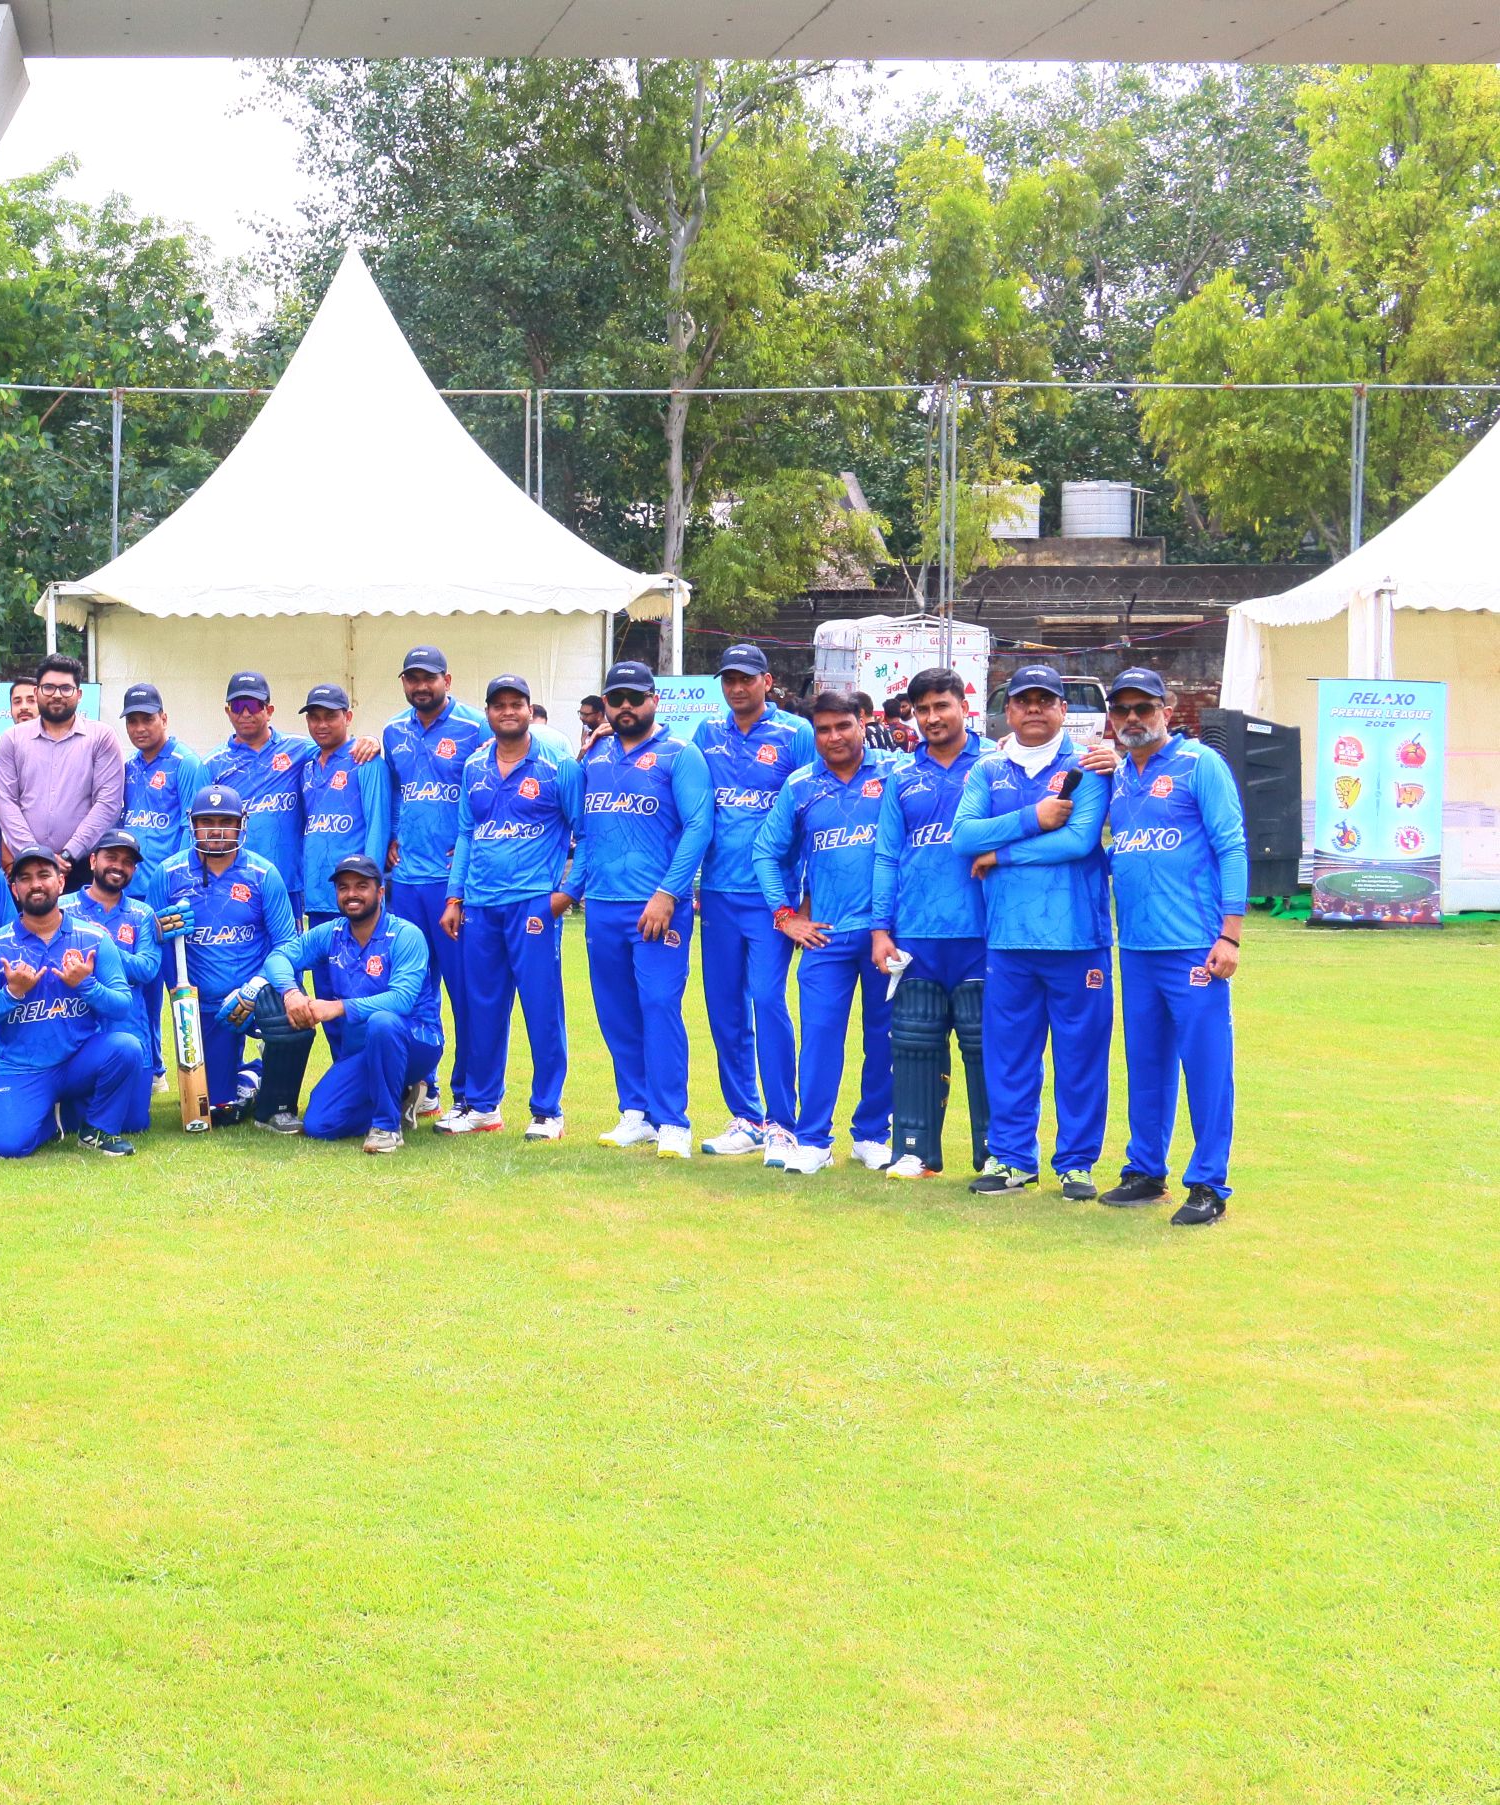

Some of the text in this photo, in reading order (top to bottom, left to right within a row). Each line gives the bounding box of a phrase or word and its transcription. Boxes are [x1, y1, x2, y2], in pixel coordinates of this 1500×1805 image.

[956, 637, 966, 646] JI
[655, 703, 720, 713] MIER LEAGUE
[1348, 692, 1416, 706] RELAXO
[1330, 707, 1433, 720] PREMIER LEAGUE
[1364, 720, 1396, 728] 2026
[241, 791, 298, 814] ELAXO
[583, 792, 659, 815] RELAXO
[714, 787, 780, 809] ELAXO
[812, 823, 878, 852] RELAX
[1113, 827, 1182, 855] ELAXO
[7, 997, 90, 1024] RELAXO
